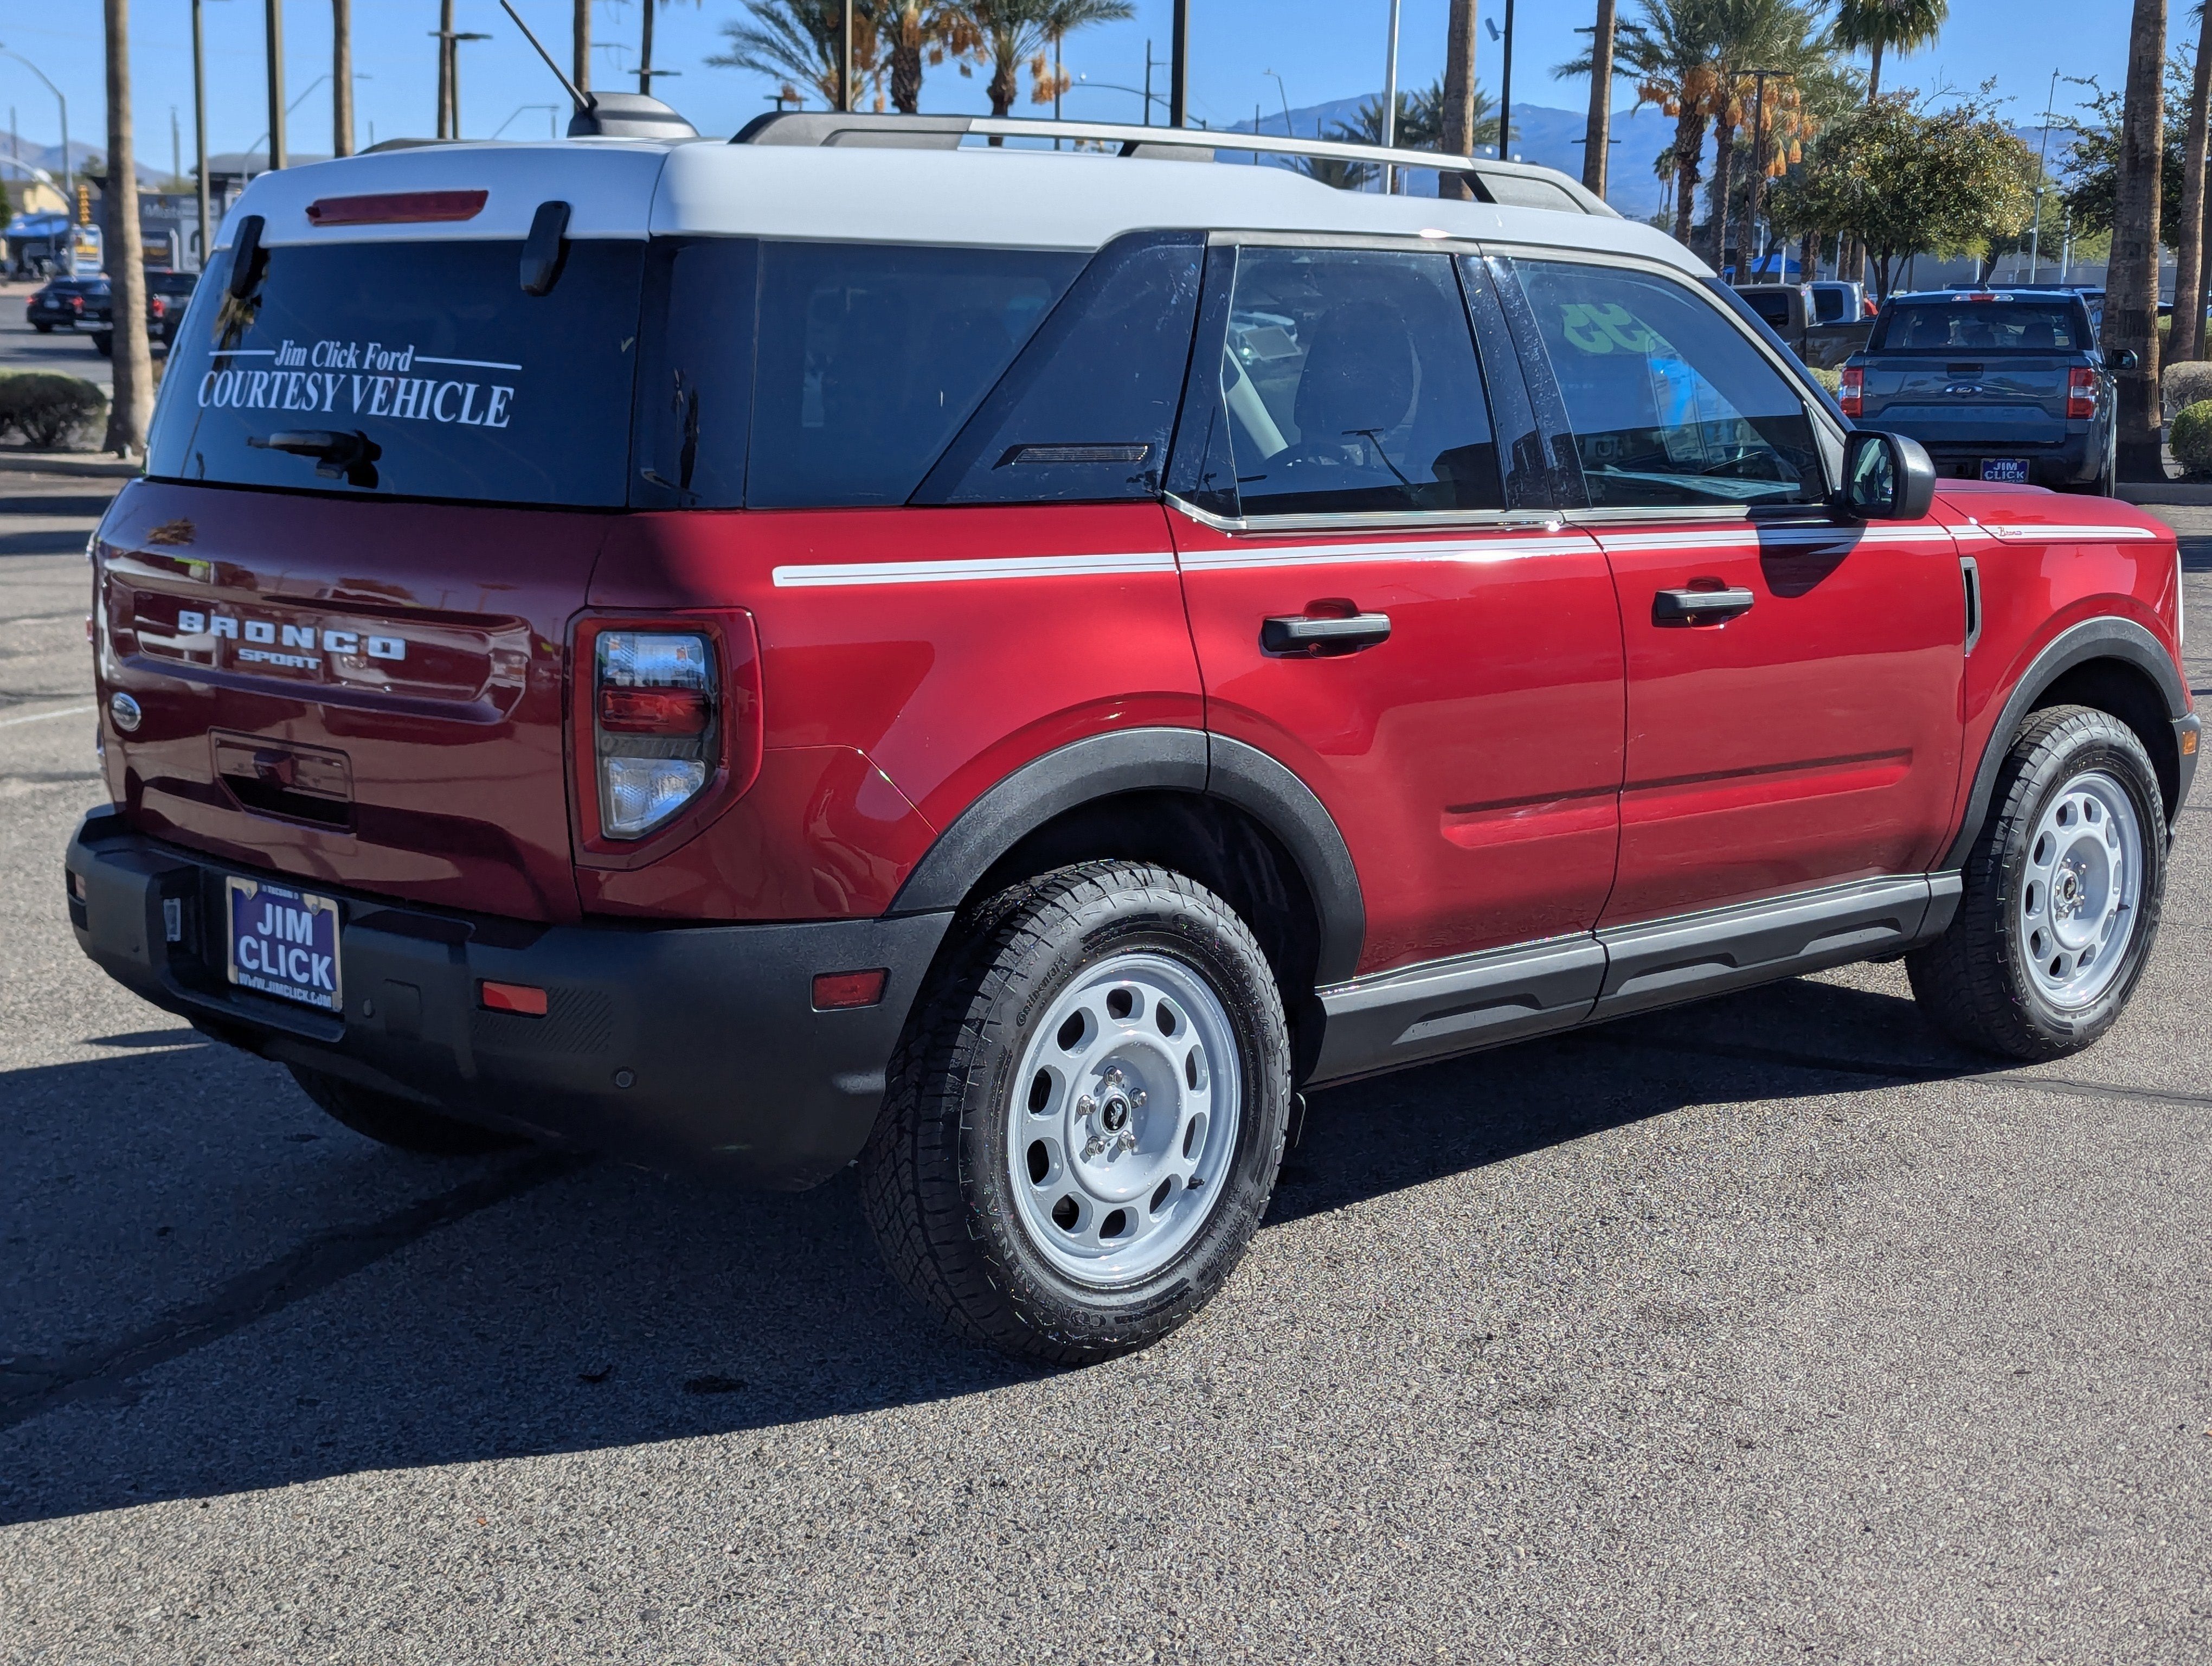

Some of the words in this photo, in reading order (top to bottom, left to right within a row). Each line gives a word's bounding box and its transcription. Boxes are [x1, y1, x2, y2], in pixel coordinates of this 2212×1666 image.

[274, 339, 307, 367] Jim
[312, 340, 358, 369] Click
[363, 342, 415, 372] Ford
[197, 369, 346, 412] COURTESY
[351, 375, 515, 428] VEHICLE
[1984, 470, 2024, 480] CLICK
[1993, 462, 2018, 471] JIM
[178, 610, 407, 661] BRONCO
[239, 648, 323, 670] SPORT
[257, 902, 313, 946] JIM
[239, 935, 333, 990] CLICK
